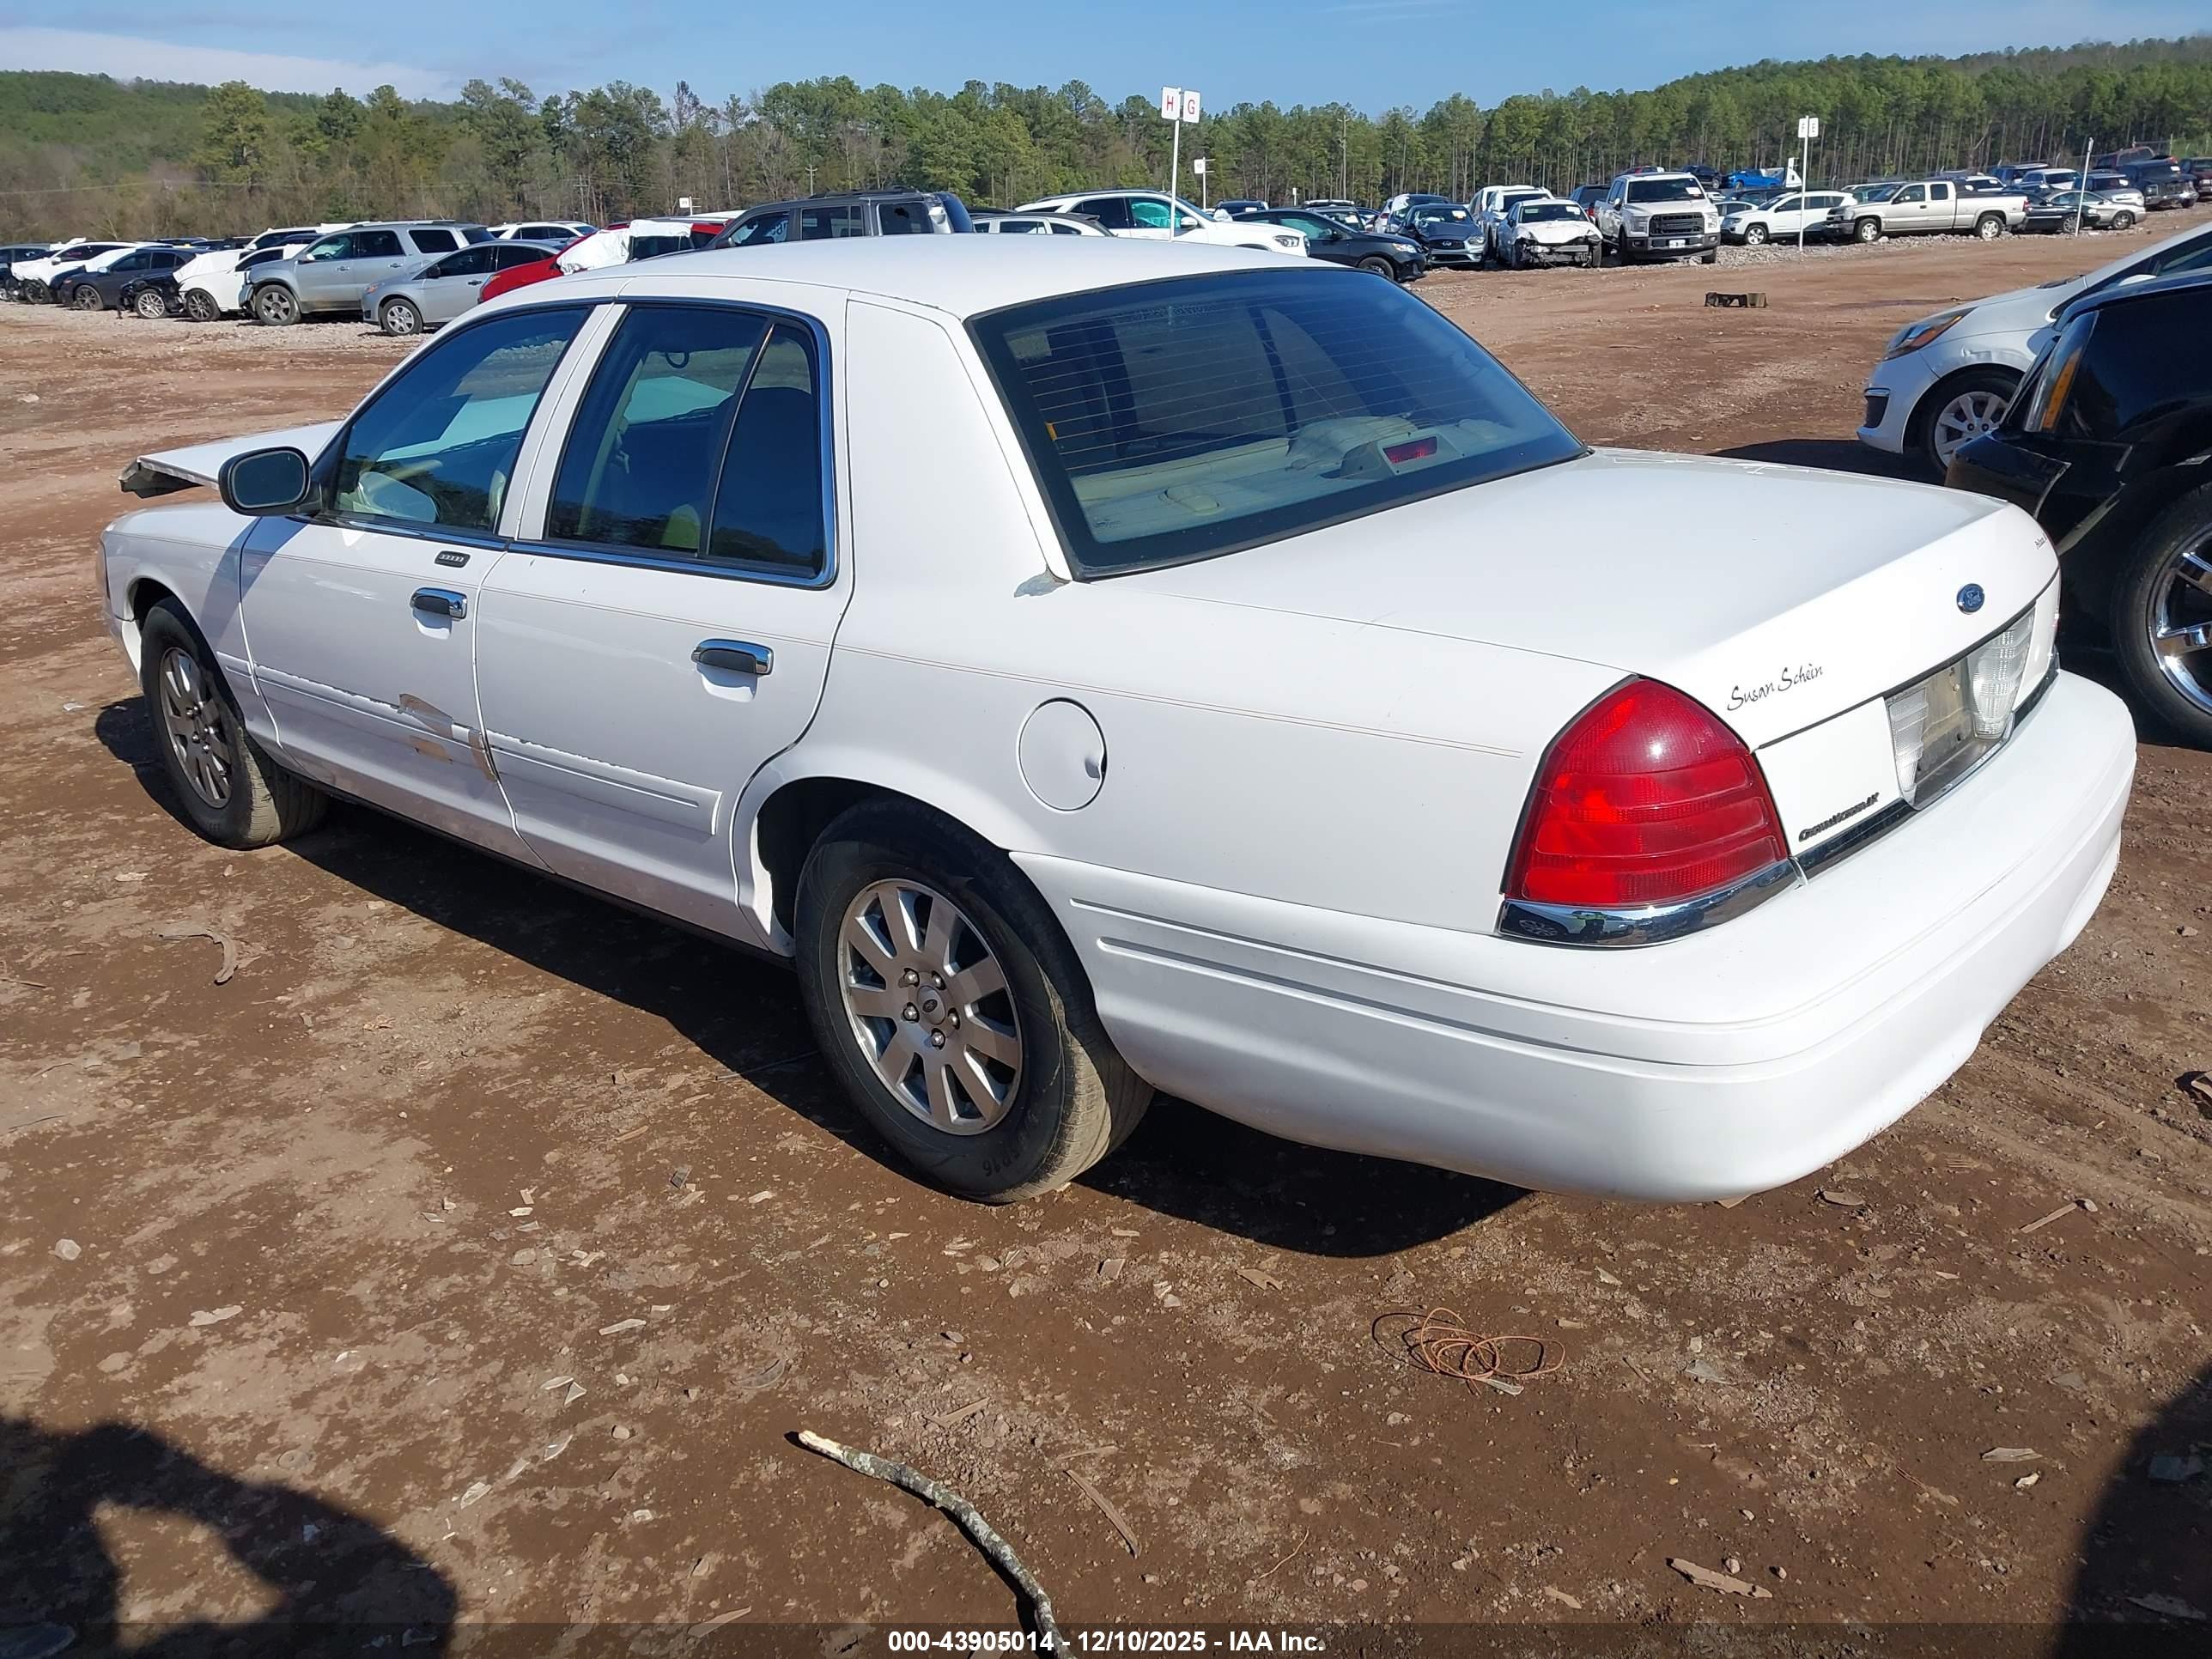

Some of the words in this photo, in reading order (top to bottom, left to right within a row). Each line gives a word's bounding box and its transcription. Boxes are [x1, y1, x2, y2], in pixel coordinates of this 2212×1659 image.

[1166, 94, 1174, 112] H
[1187, 99, 1195, 114] G
[1727, 682, 1775, 711] Susan
[1778, 663, 1823, 691] Schein
